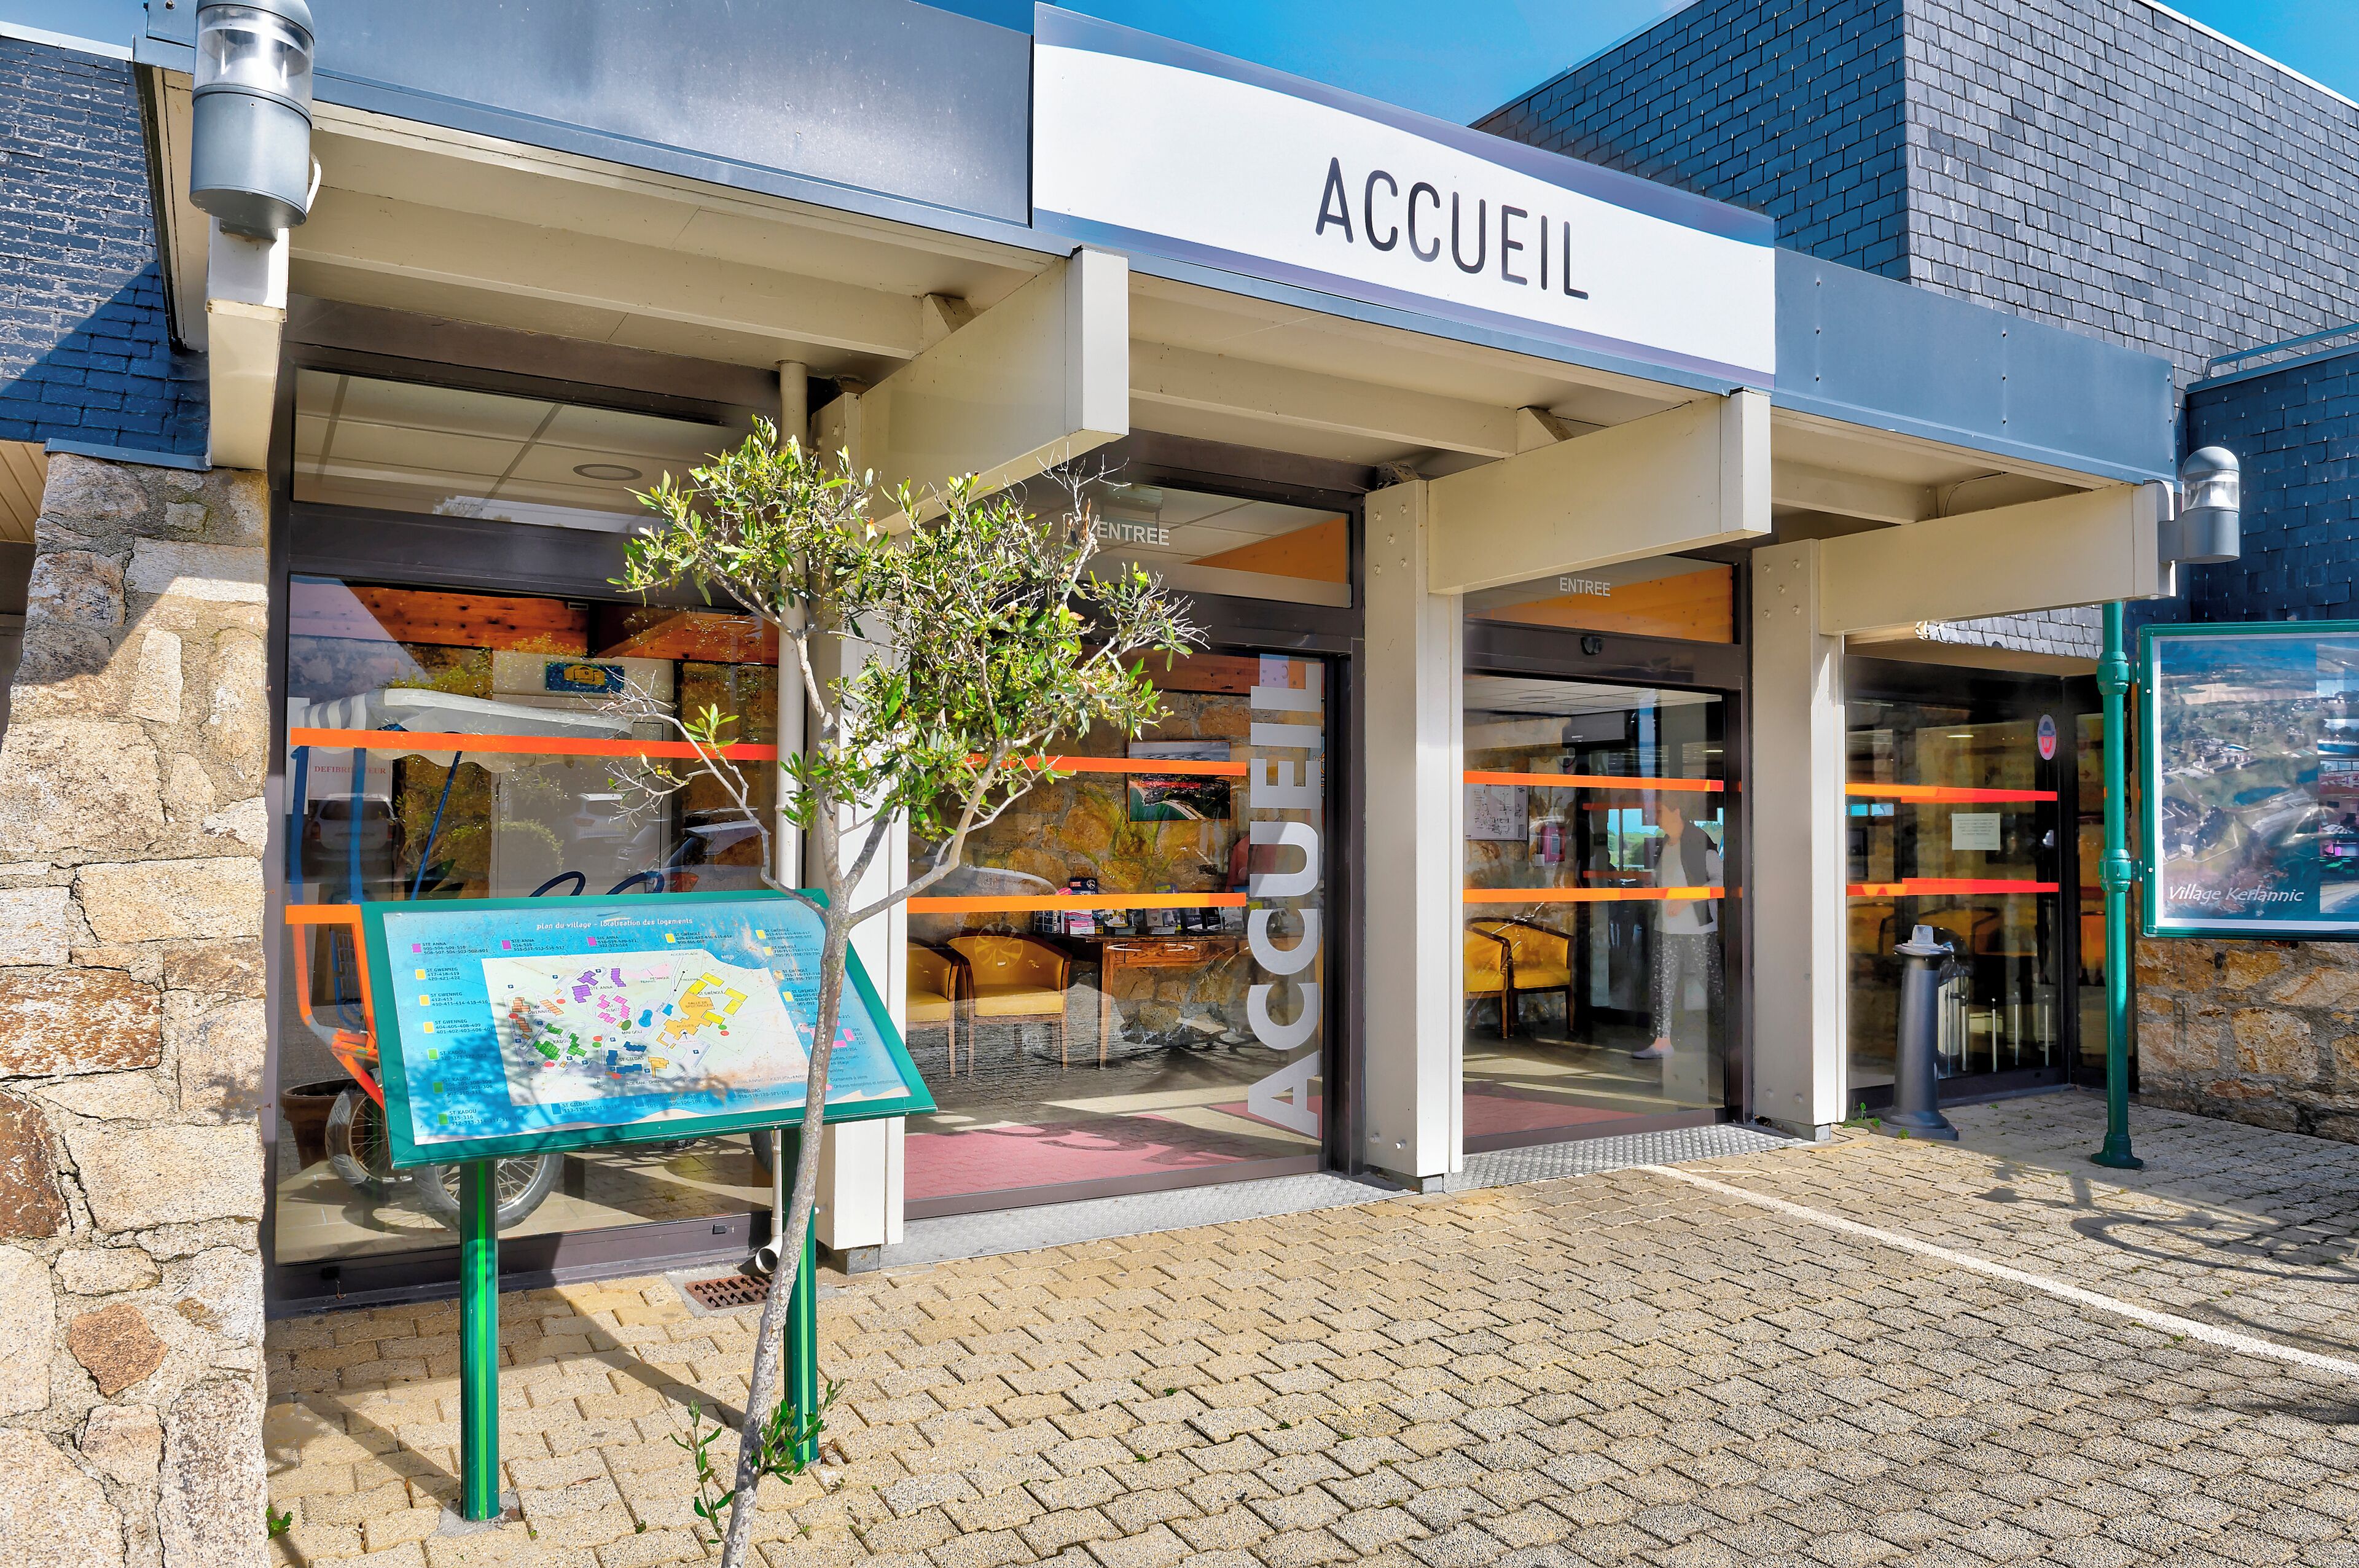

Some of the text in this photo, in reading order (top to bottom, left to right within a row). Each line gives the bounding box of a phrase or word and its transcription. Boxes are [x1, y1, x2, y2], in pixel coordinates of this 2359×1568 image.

[1315, 155, 1589, 301] ACCUEIL
[1097, 521, 1170, 546] ENTREE
[1559, 577, 1611, 597] ENTREE
[1247, 663, 1322, 1138] ACCUEIL
[2169, 883, 2305, 905] Village Kerlannic
[566, 921, 592, 930] village
[657, 918, 692, 926] logements
